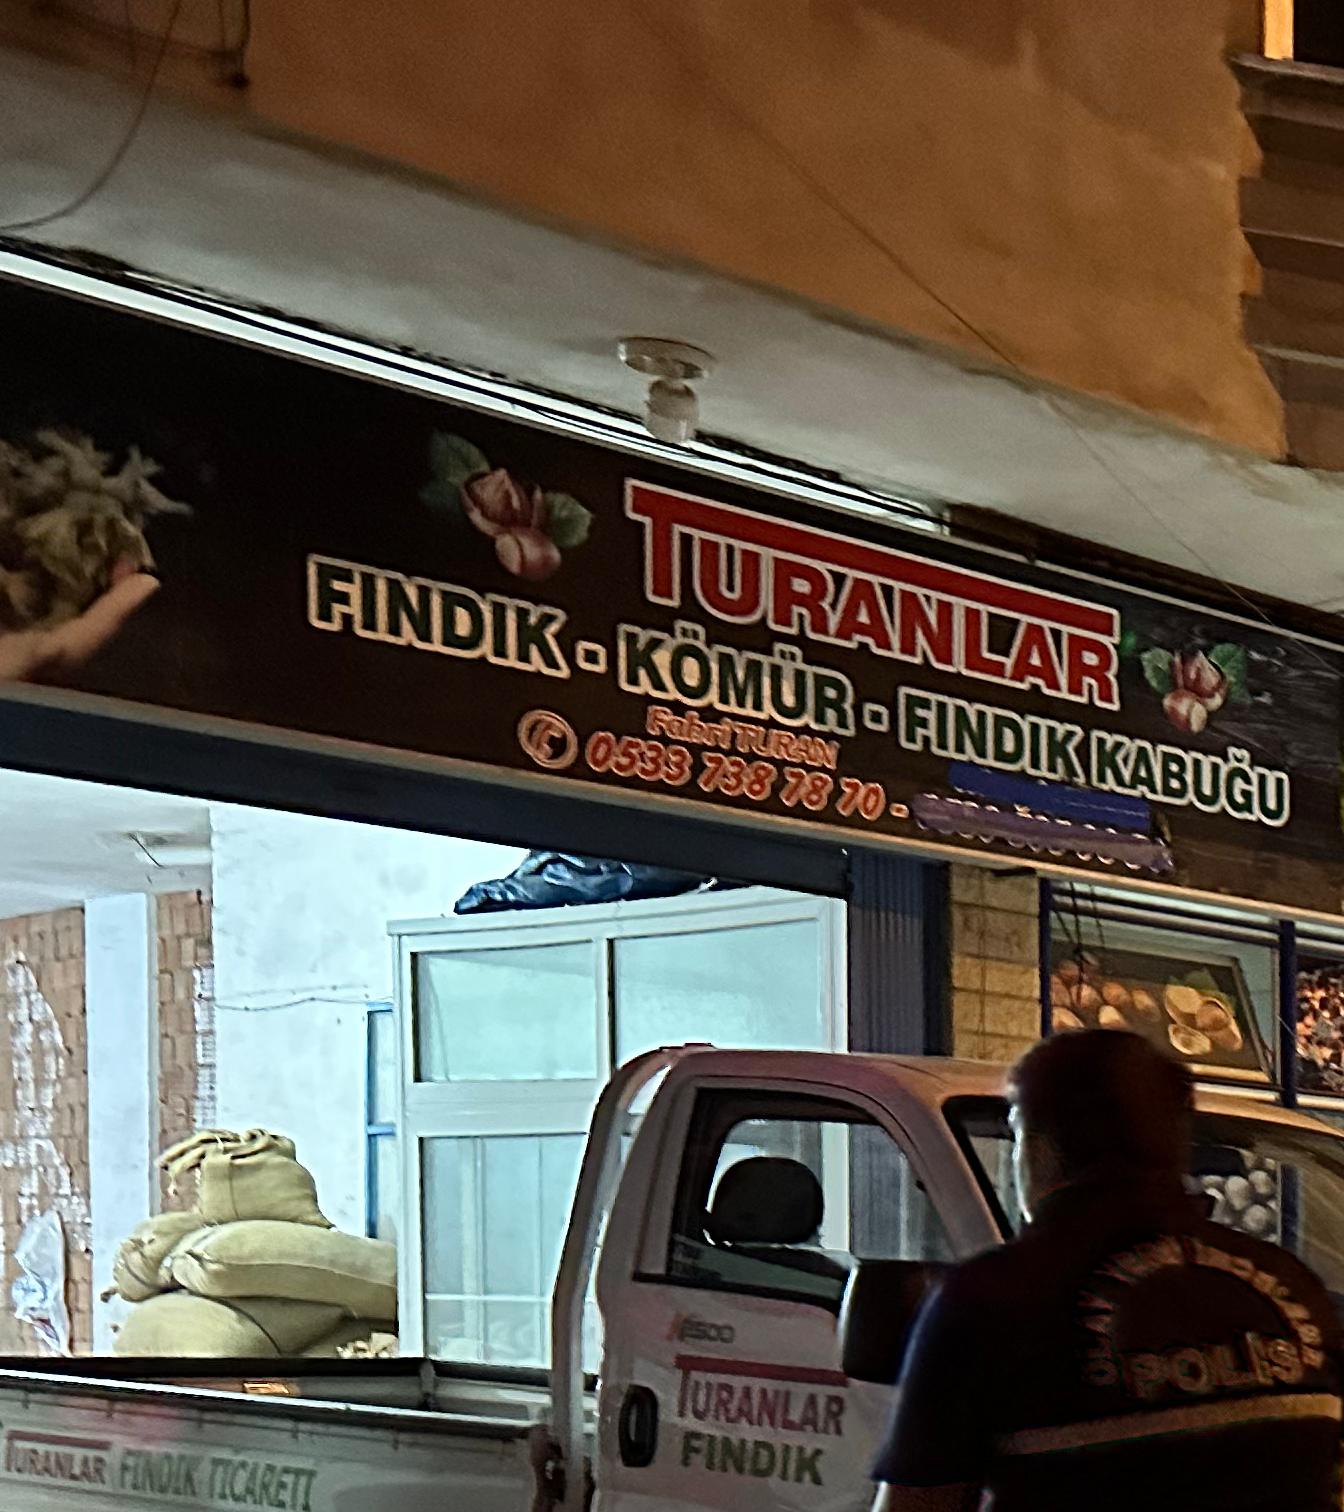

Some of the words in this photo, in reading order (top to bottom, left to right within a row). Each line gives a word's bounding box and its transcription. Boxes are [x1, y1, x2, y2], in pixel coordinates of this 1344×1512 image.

[624, 477, 1121, 711] TURANLAR
[307, 553, 570, 678] FINDIK
[617, 620, 856, 737] KÖMÜR
[897, 686, 1086, 785] FINDIK
[1090, 729, 1291, 828] KABUĞU
[585, 731, 693, 786] 0533
[699, 752, 776, 801] 738
[780, 766, 833, 811] 78
[836, 777, 886, 821] 70
[734, 720, 841, 770] TURAN
[674, 1353, 849, 1437] TURANLAR
[5, 1430, 112, 1485] TURANLAR
[120, 1449, 204, 1497] FINDIK
[681, 1430, 823, 1486] FINDIK
